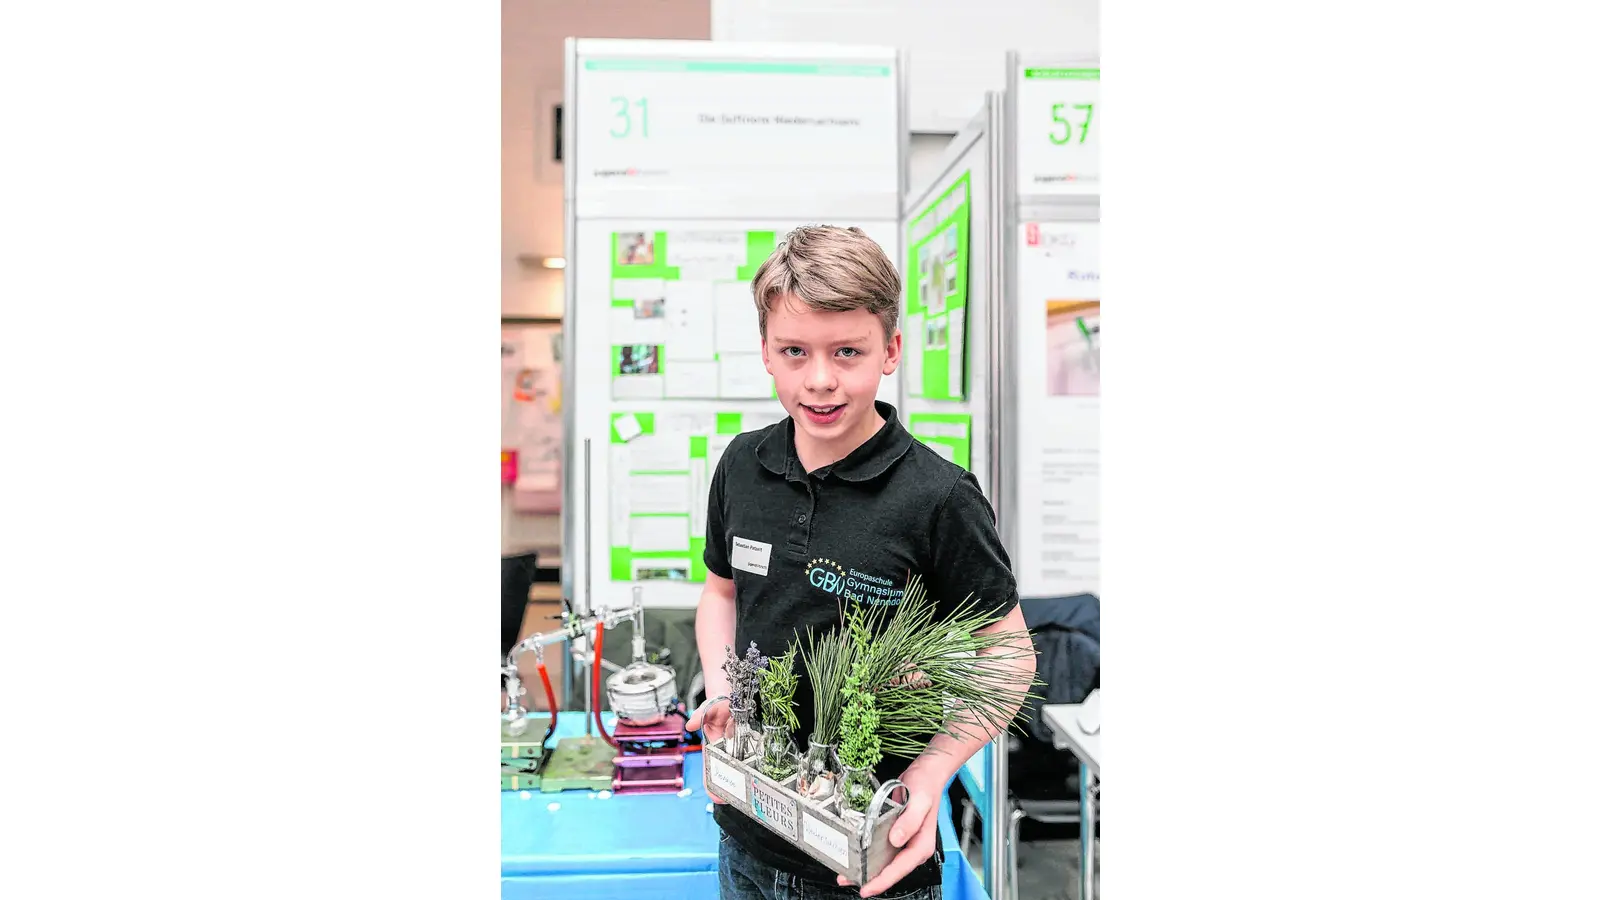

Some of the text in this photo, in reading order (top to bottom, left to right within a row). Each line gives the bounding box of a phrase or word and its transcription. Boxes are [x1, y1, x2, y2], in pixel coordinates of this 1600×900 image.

[609, 96, 650, 139] 31
[1049, 103, 1093, 145] 57
[846, 577, 904, 598] Gymnasium
[849, 568, 893, 587] Europaschule
[844, 588, 864, 603] Bad
[753, 785, 793, 818] PETITES
[754, 798, 794, 831] FLEURS
